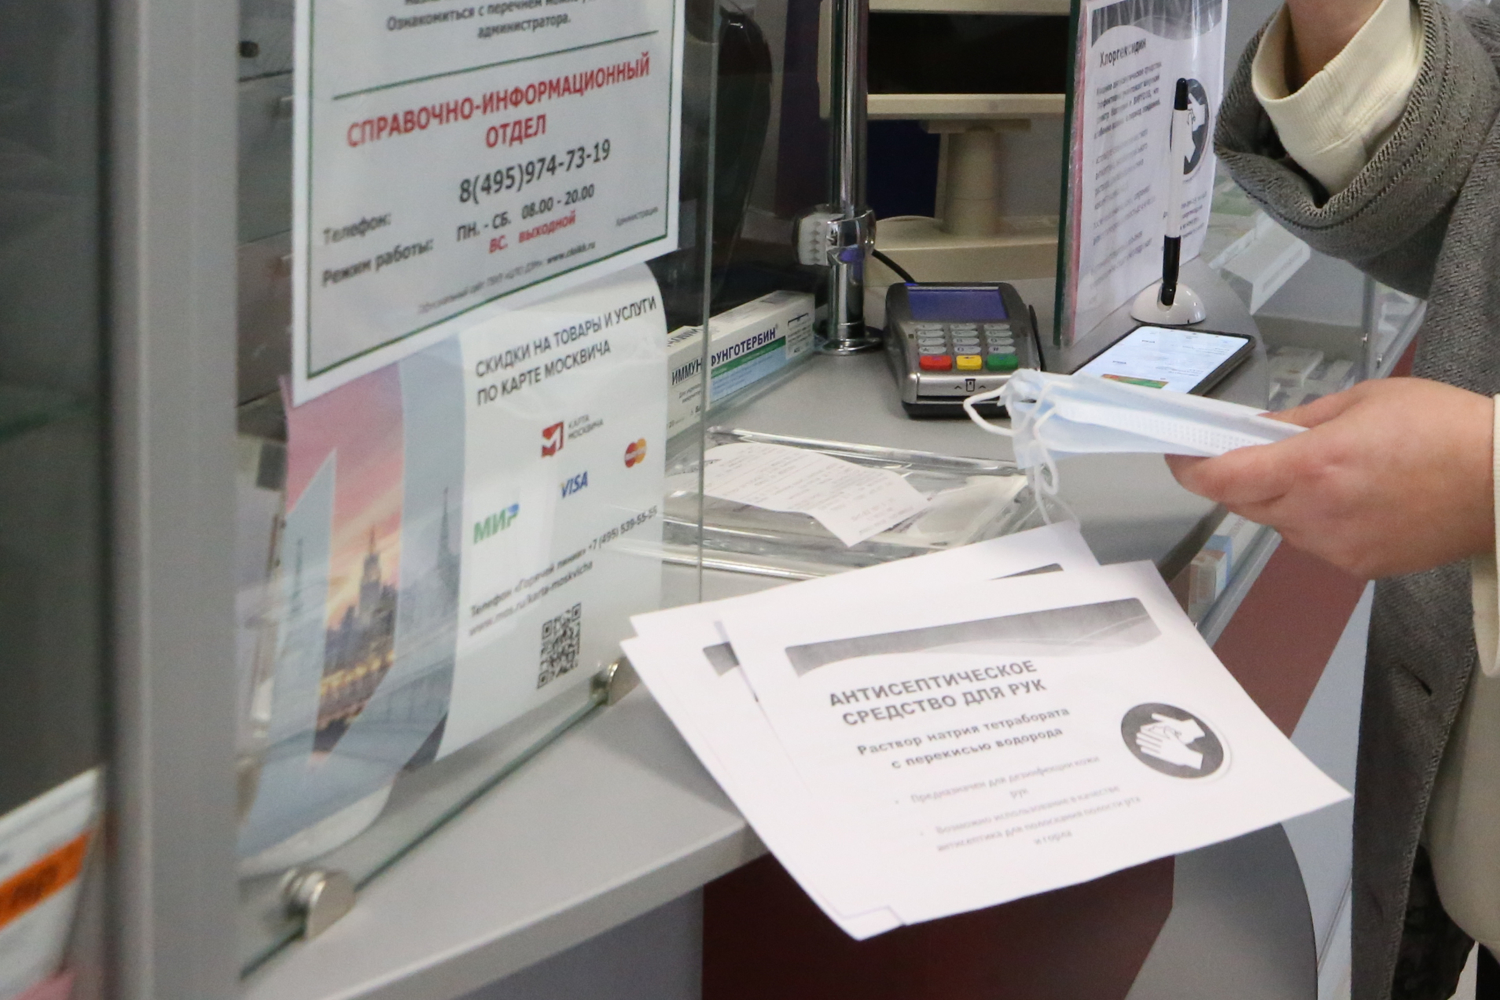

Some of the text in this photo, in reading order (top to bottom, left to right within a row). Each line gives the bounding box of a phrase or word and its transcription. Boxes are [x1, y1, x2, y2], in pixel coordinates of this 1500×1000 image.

[386, 7, 475, 31] Ознакомиться
[478, 6, 484, 16] с
[477, 13, 571, 38] администратора.
[347, 52, 650, 148] СПРАВОЧНО-ИНФОРМАЦИОННЫЙ
[485, 114, 547, 150] ОТДЕЛ
[323, 138, 611, 245] Телефон: 8(495)974-73-19
[321, 258, 371, 287] Режим
[375, 238, 434, 271] работы:
[457, 222, 480, 241] ПН.
[492, 211, 511, 230] СБ.
[521, 197, 554, 221] 08.00
[564, 184, 595, 206] 20.00
[489, 210, 577, 253] ВС. выходной
[476, 296, 656, 378] СКИДКИ НА ТОВАРЫ И УСЛУГИ
[478, 340, 611, 406] ПО КАРТЕ МОСКВИЧА
[561, 471, 588, 498] VISA
[474, 503, 519, 544] МИР
[600, 528, 618, 548] (495)
[830, 660, 1037, 707] АНТИСЕПТИЧЕСКОЕ
[842, 679, 1046, 726] СРЕДСТВО ДЛЯ РУК
[857, 707, 1070, 756] Раствор натрия тетрабората
[892, 727, 1063, 769] с перекисью водорода
